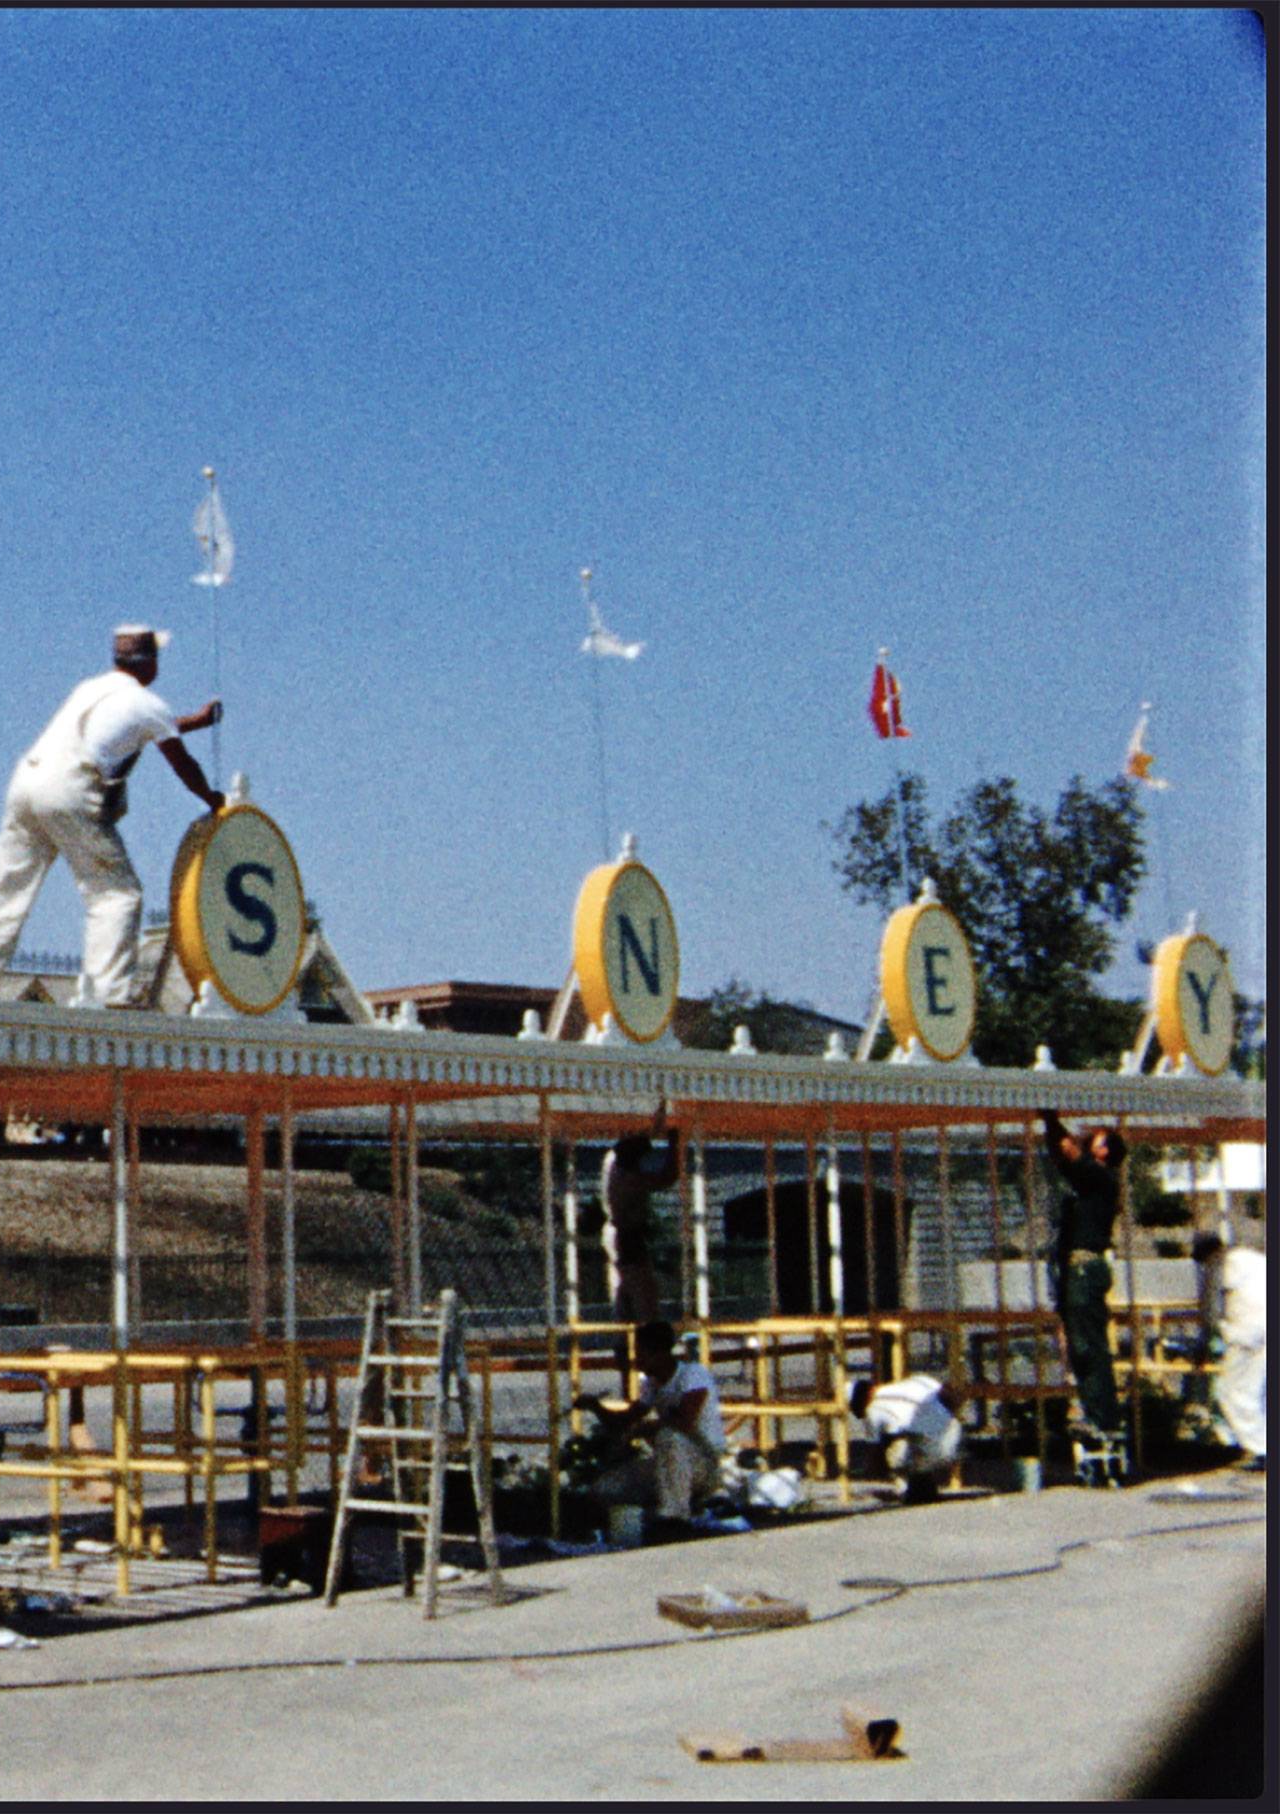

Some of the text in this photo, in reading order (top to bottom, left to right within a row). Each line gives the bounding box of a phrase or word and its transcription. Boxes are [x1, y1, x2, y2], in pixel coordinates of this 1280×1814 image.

[224, 861, 278, 958] S
[616, 913, 661, 996] N
[922, 945, 957, 1016] E
[1186, 971, 1219, 1034] Y
